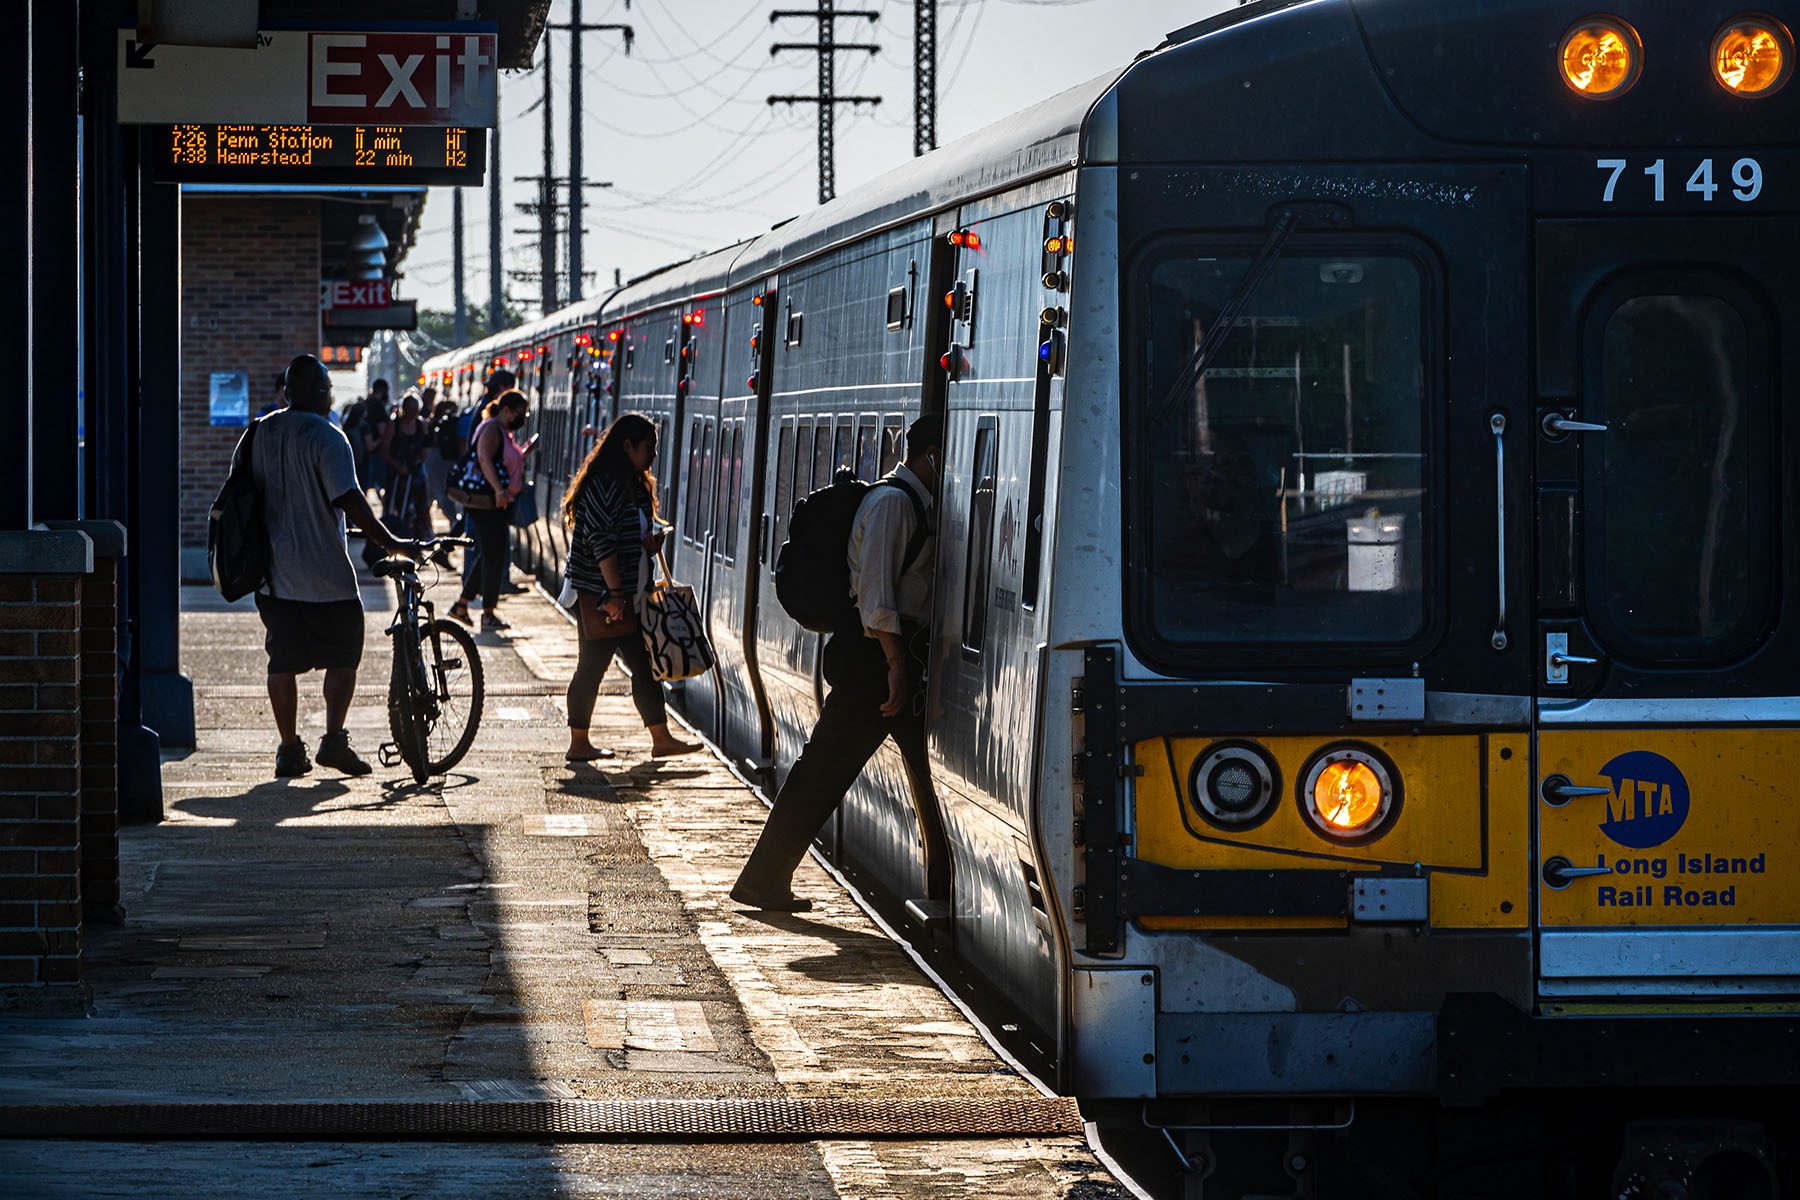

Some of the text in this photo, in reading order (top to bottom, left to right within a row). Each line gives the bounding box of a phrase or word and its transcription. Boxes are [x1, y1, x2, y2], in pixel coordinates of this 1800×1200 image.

[311, 34, 490, 109] Exit
[172, 131, 207, 147] 7:26
[217, 131, 259, 148] Penn
[269, 132, 333, 149] Station
[374, 133, 401, 150] min
[172, 147, 466, 167] 7:38 Hempstead 22 min H2
[1597, 157, 1763, 202] 7149
[334, 281, 386, 305] Exit
[1598, 775, 1674, 825] MTA
[1598, 853, 1765, 878] Long Island
[1598, 885, 1736, 906] Rail Road
